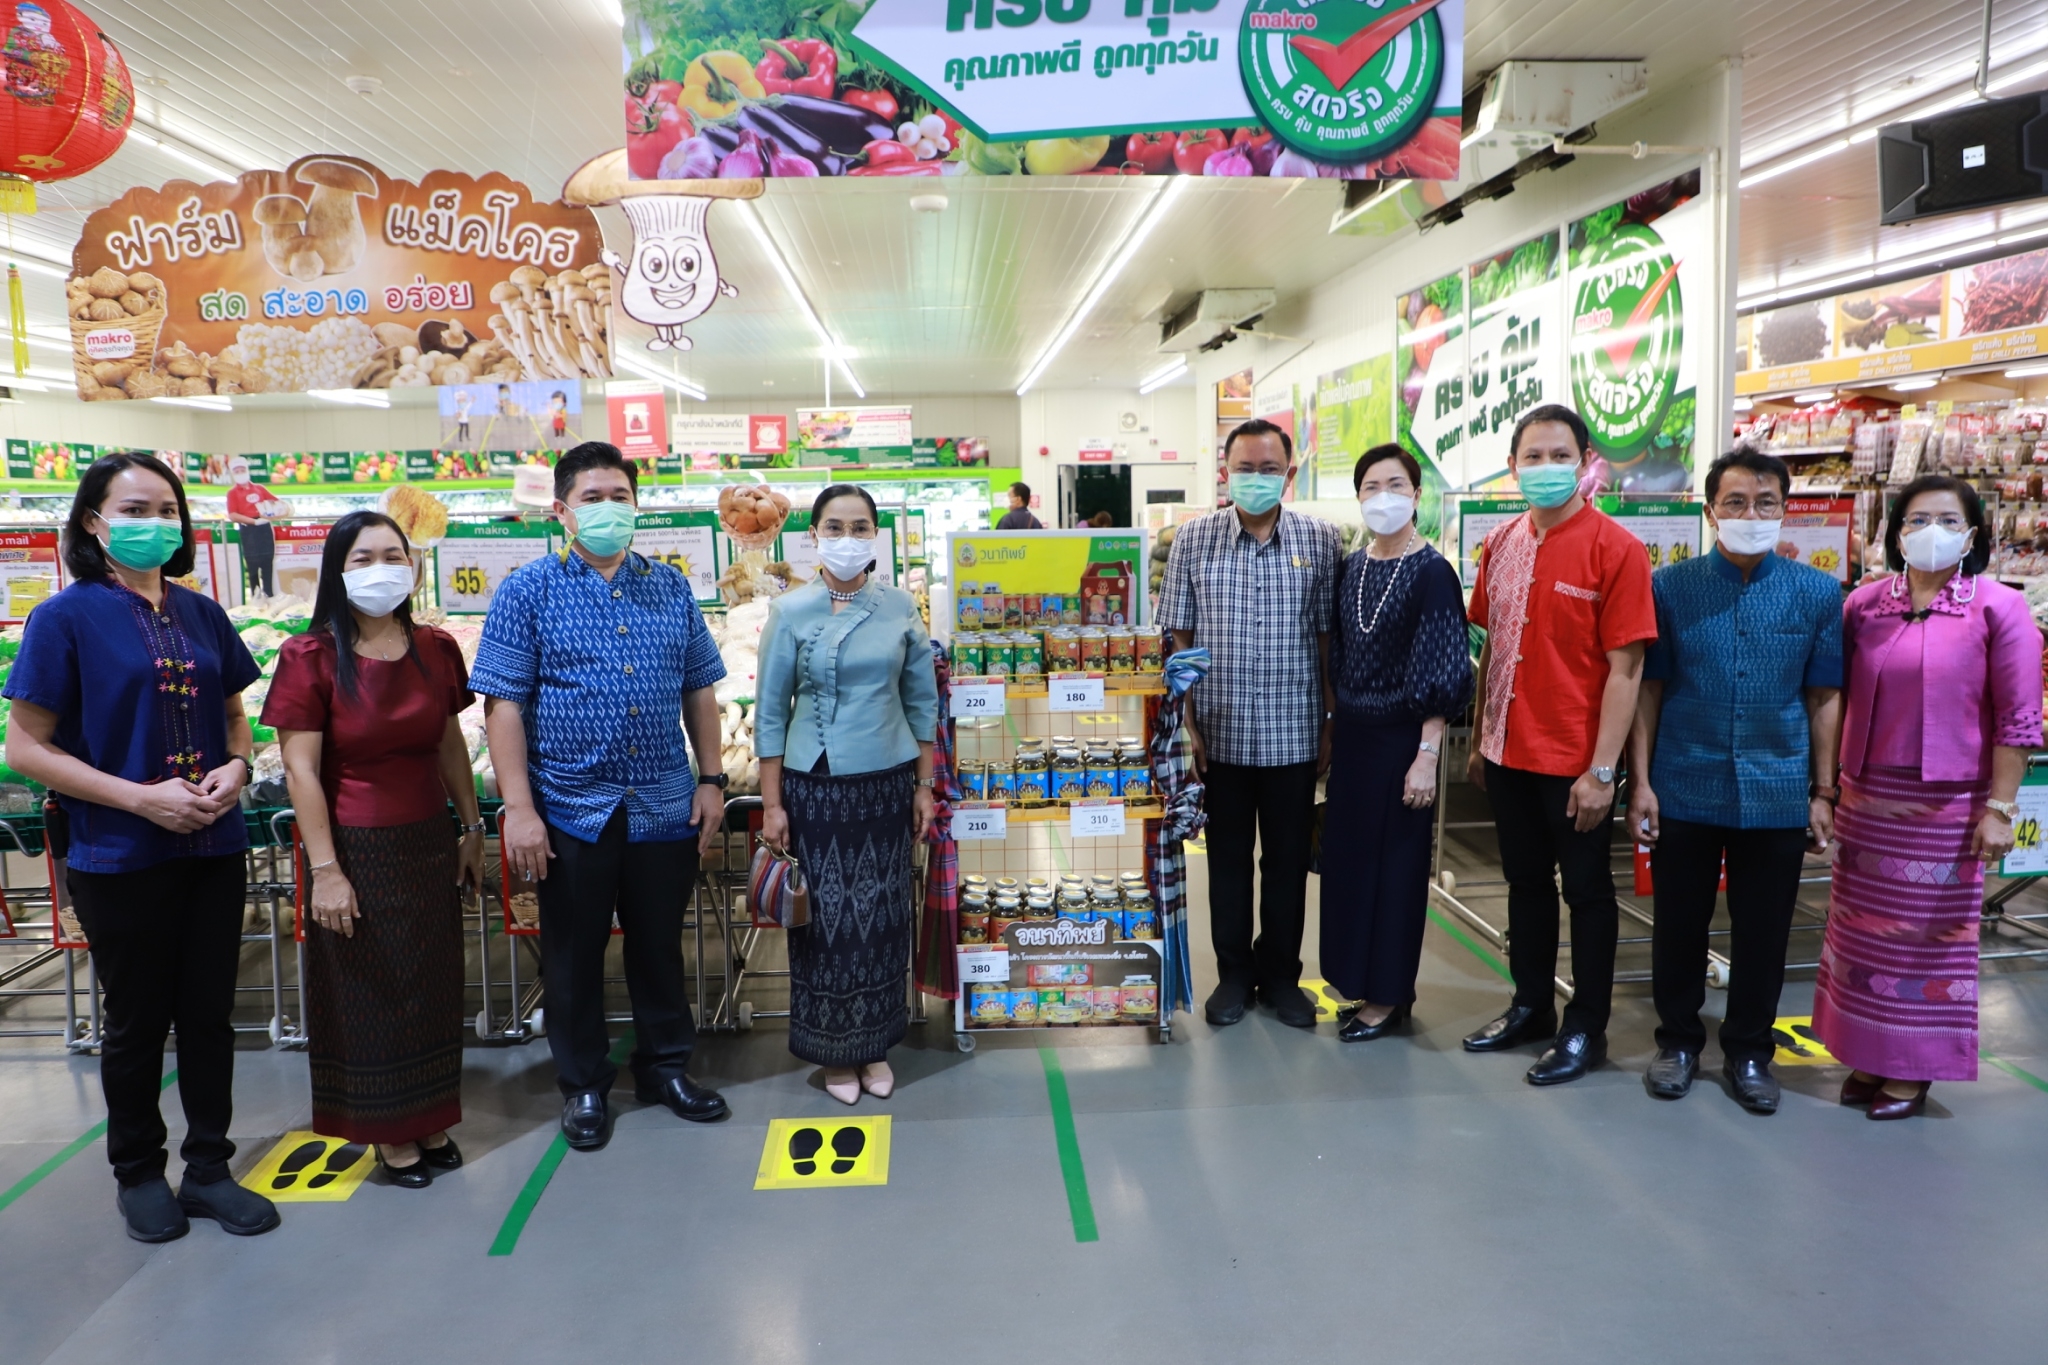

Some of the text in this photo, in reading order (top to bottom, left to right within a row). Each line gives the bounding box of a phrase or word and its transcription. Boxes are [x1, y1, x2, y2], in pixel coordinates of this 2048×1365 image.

[1250, 9, 1317, 30] makro
[944, 30, 1219, 91] คุณภาพดี ถูกทุกวัน
[1292, 83, 1383, 120] สดจริง
[1270, 98, 1293, 120] ครบ
[108, 191, 577, 267] ฟาร์ม แม็คโคร
[201, 275, 471, 319] สด สะอาด อร่อย
[1576, 308, 1612, 331] makro
[87, 333, 131, 345] makro
[1589, 361, 1654, 415] สดจริง
[1497, 501, 1529, 511] makro
[1638, 504, 1669, 514] makro
[1785, 501, 1830, 511] akro mail
[638, 516, 672, 526] makro
[290, 527, 324, 537] makro
[474, 525, 509, 535] makro
[5, 536, 29, 545] mail
[980, 545, 1027, 560] วนาทิพย์
[1673, 541, 1689, 564] 34
[455, 567, 480, 594] 55
[965, 698, 986, 708] 220
[1066, 692, 1086, 702] 180
[968, 821, 988, 831] 210
[1090, 815, 1109, 825] 310
[2017, 818, 2037, 846] 42
[1015, 919, 1108, 947] วนาทิพย์
[971, 964, 991, 974] 380
